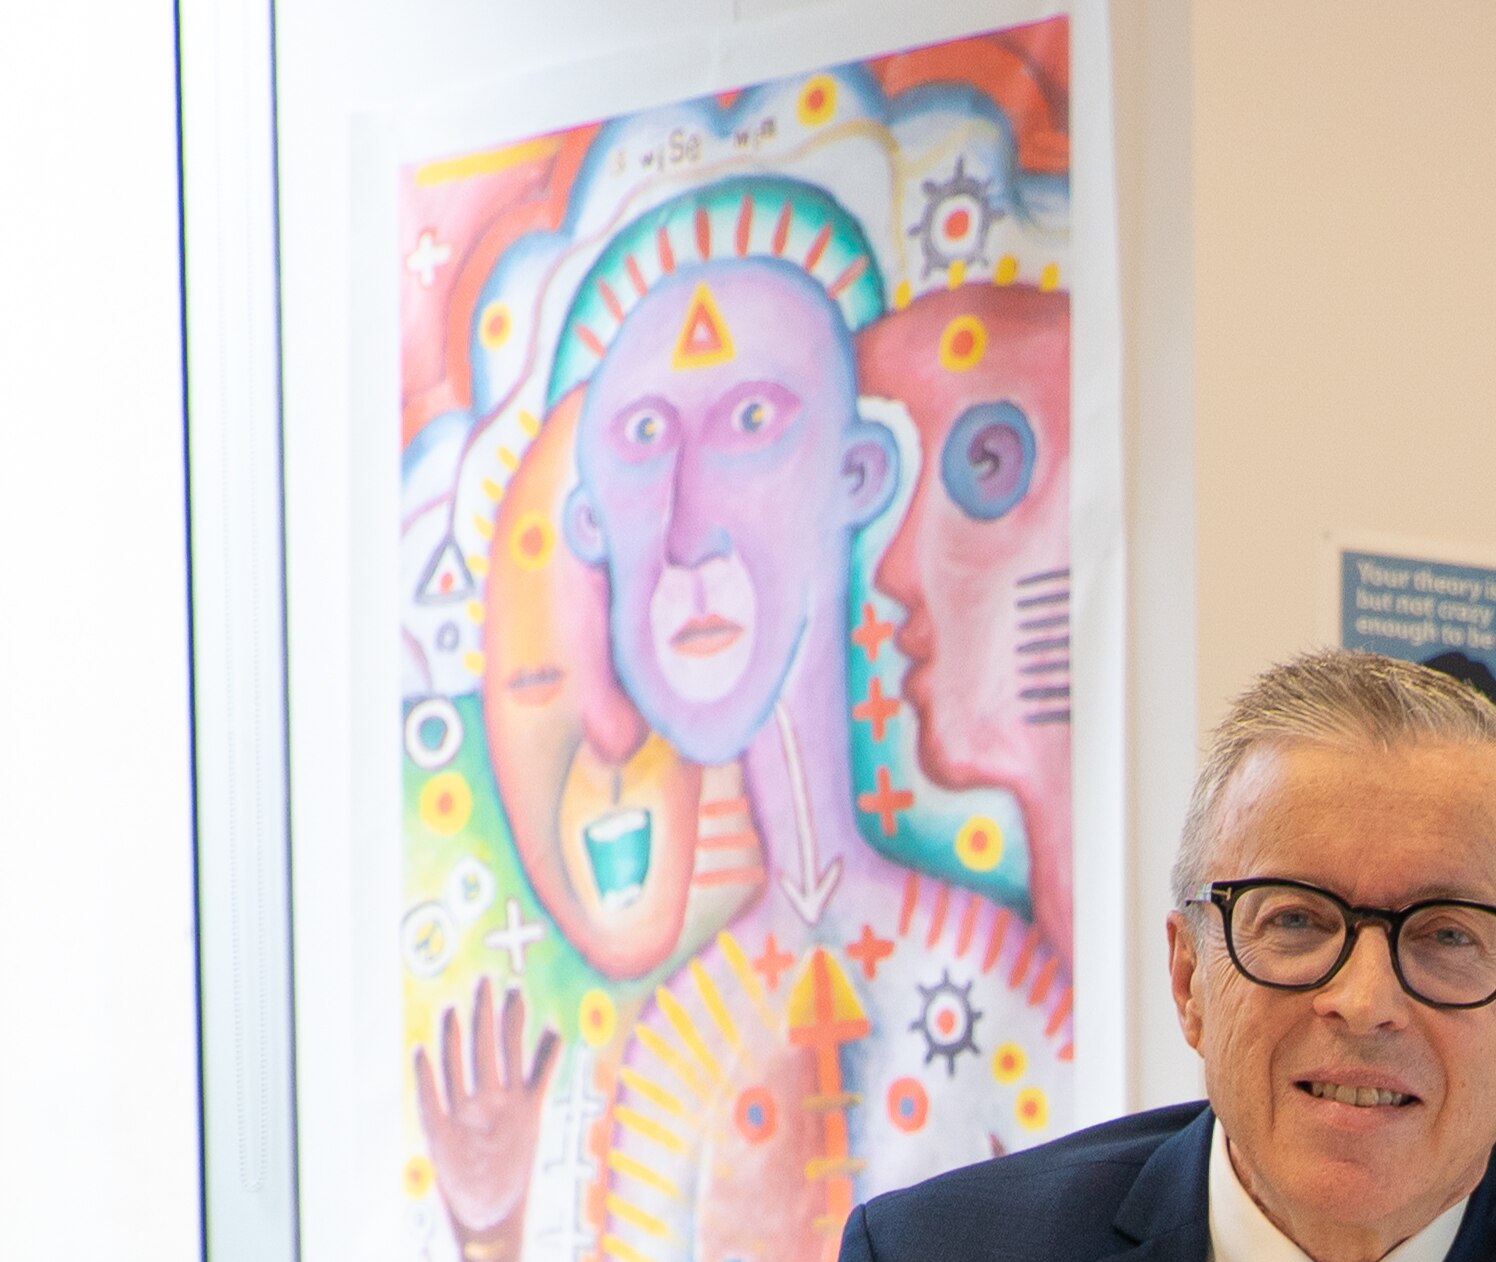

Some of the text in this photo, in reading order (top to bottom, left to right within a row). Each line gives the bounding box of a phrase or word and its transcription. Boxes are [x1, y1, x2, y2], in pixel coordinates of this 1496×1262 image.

[1357, 560, 1410, 589] Your
[1414, 570, 1481, 602] theory
[1356, 586, 1494, 629] but not crazy
[1356, 617, 1438, 646] enough
[1441, 623, 1464, 646] to
[1467, 624, 1495, 651] be
